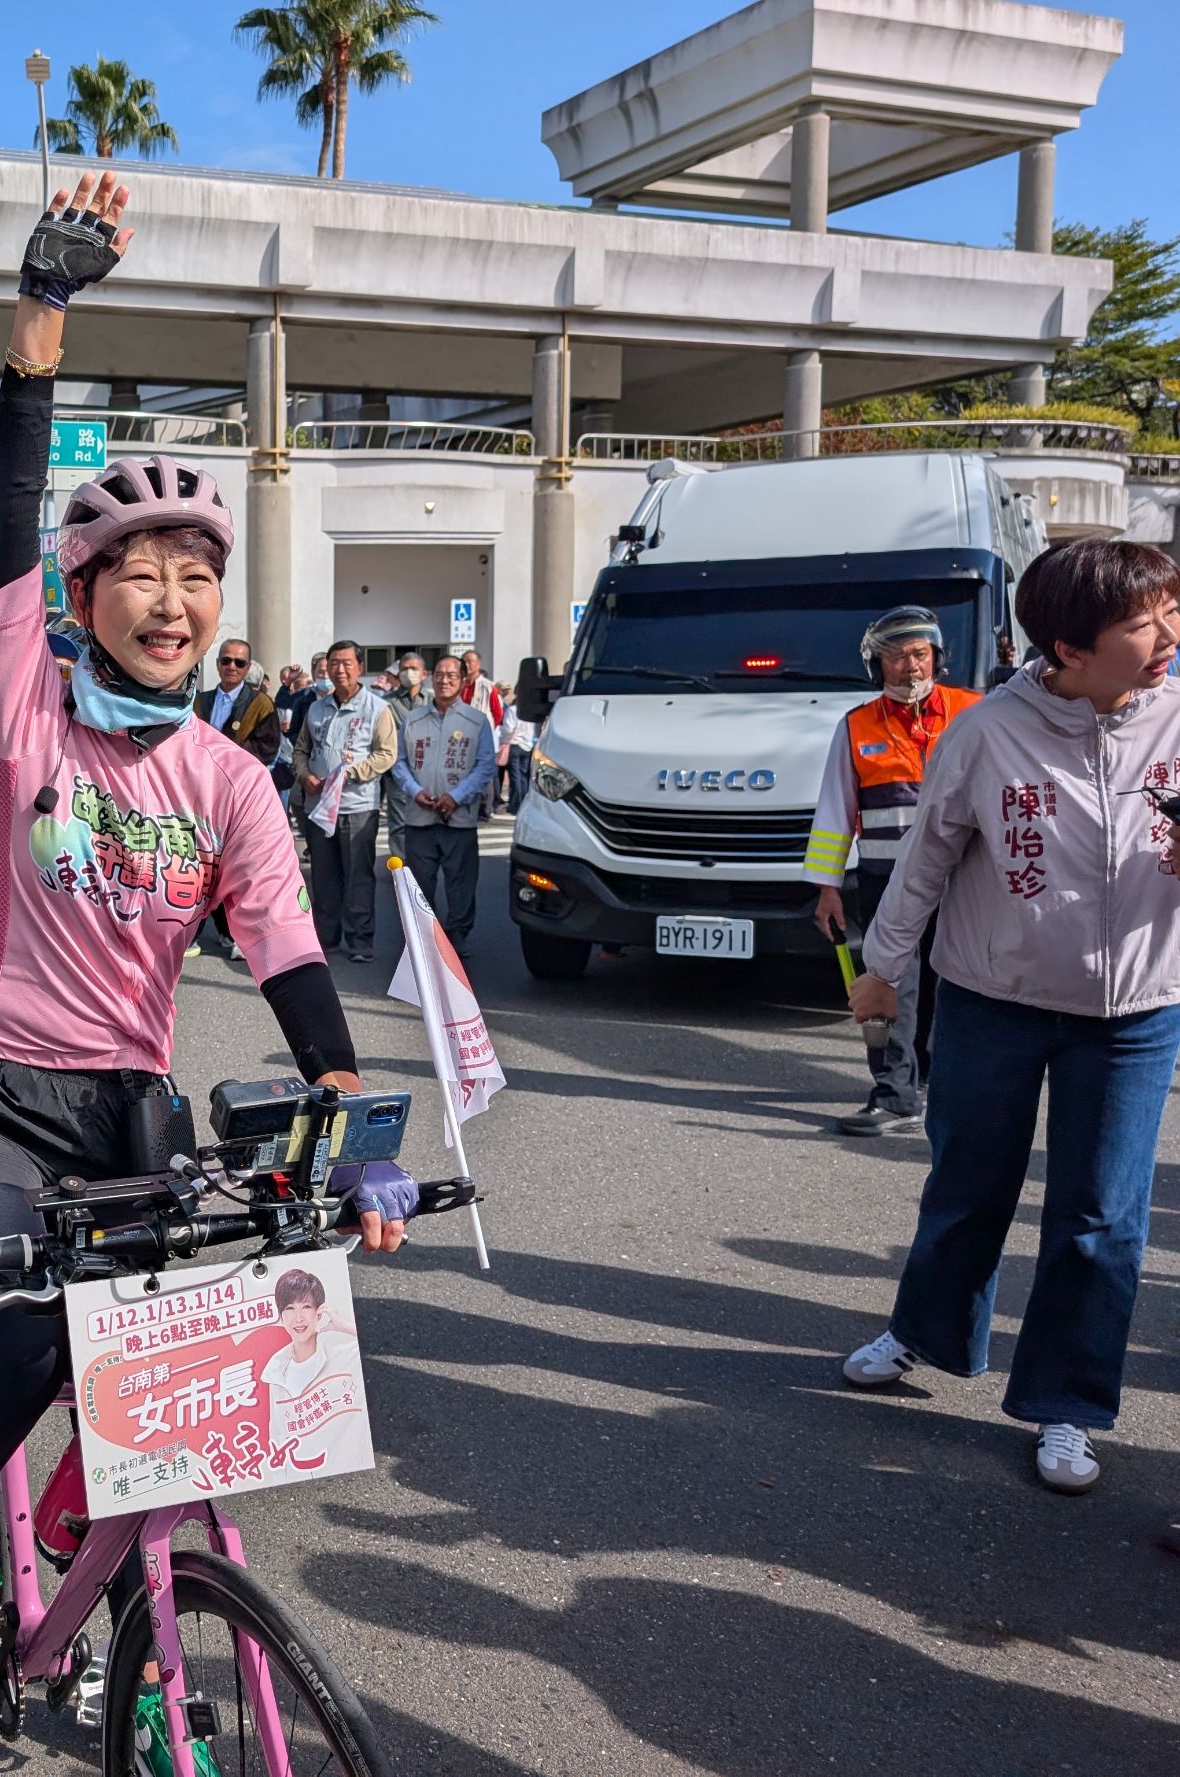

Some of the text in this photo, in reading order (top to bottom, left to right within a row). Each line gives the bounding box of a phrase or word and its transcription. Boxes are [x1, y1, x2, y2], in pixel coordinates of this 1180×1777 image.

[75, 451, 95, 462] Rd.
[658, 769, 777, 791] IVECO
[1043, 781, 1057, 816] 市議員
[1002, 783, 1047, 899] 陳怡珍
[659, 926, 746, 952] BYR-1911
[95, 1283, 236, 1335] 1/12.1/13.1/14
[125, 1300, 274, 1354] 晚上6點至晚上10點
[127, 1359, 258, 1444] 女市長
[287, 1393, 353, 1432] 國會評鑑第一名
[293, 1387, 329, 1414] 經管博士
[109, 1440, 187, 1476] 市長初選電話民調
[113, 1455, 189, 1497] 唯一支持
[287, 1641, 332, 1701] GIANT
